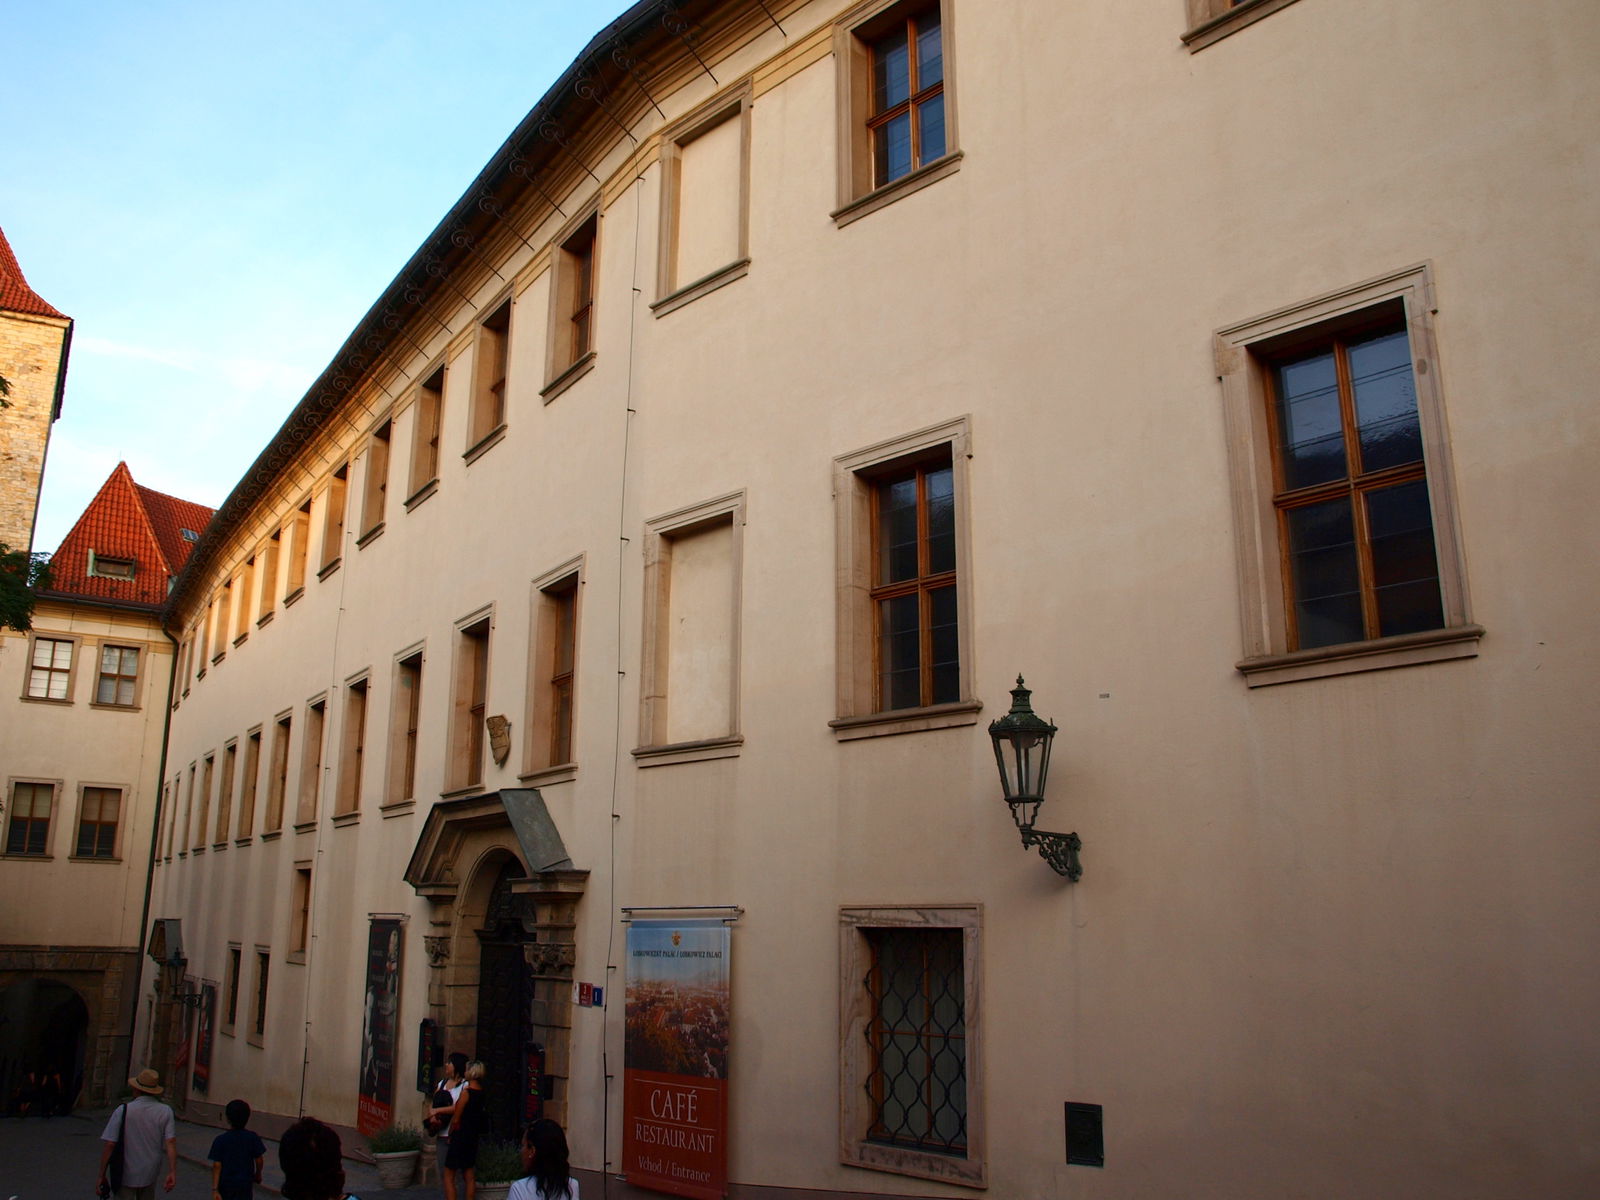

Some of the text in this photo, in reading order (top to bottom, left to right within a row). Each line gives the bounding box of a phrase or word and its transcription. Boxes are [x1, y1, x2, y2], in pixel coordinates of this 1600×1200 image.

[650, 1089, 698, 1123] CAFÉ
[636, 1123, 715, 1153] RESTAURANT
[638, 1155, 662, 1174] Vchod
[671, 1162, 711, 1182] Entrance
